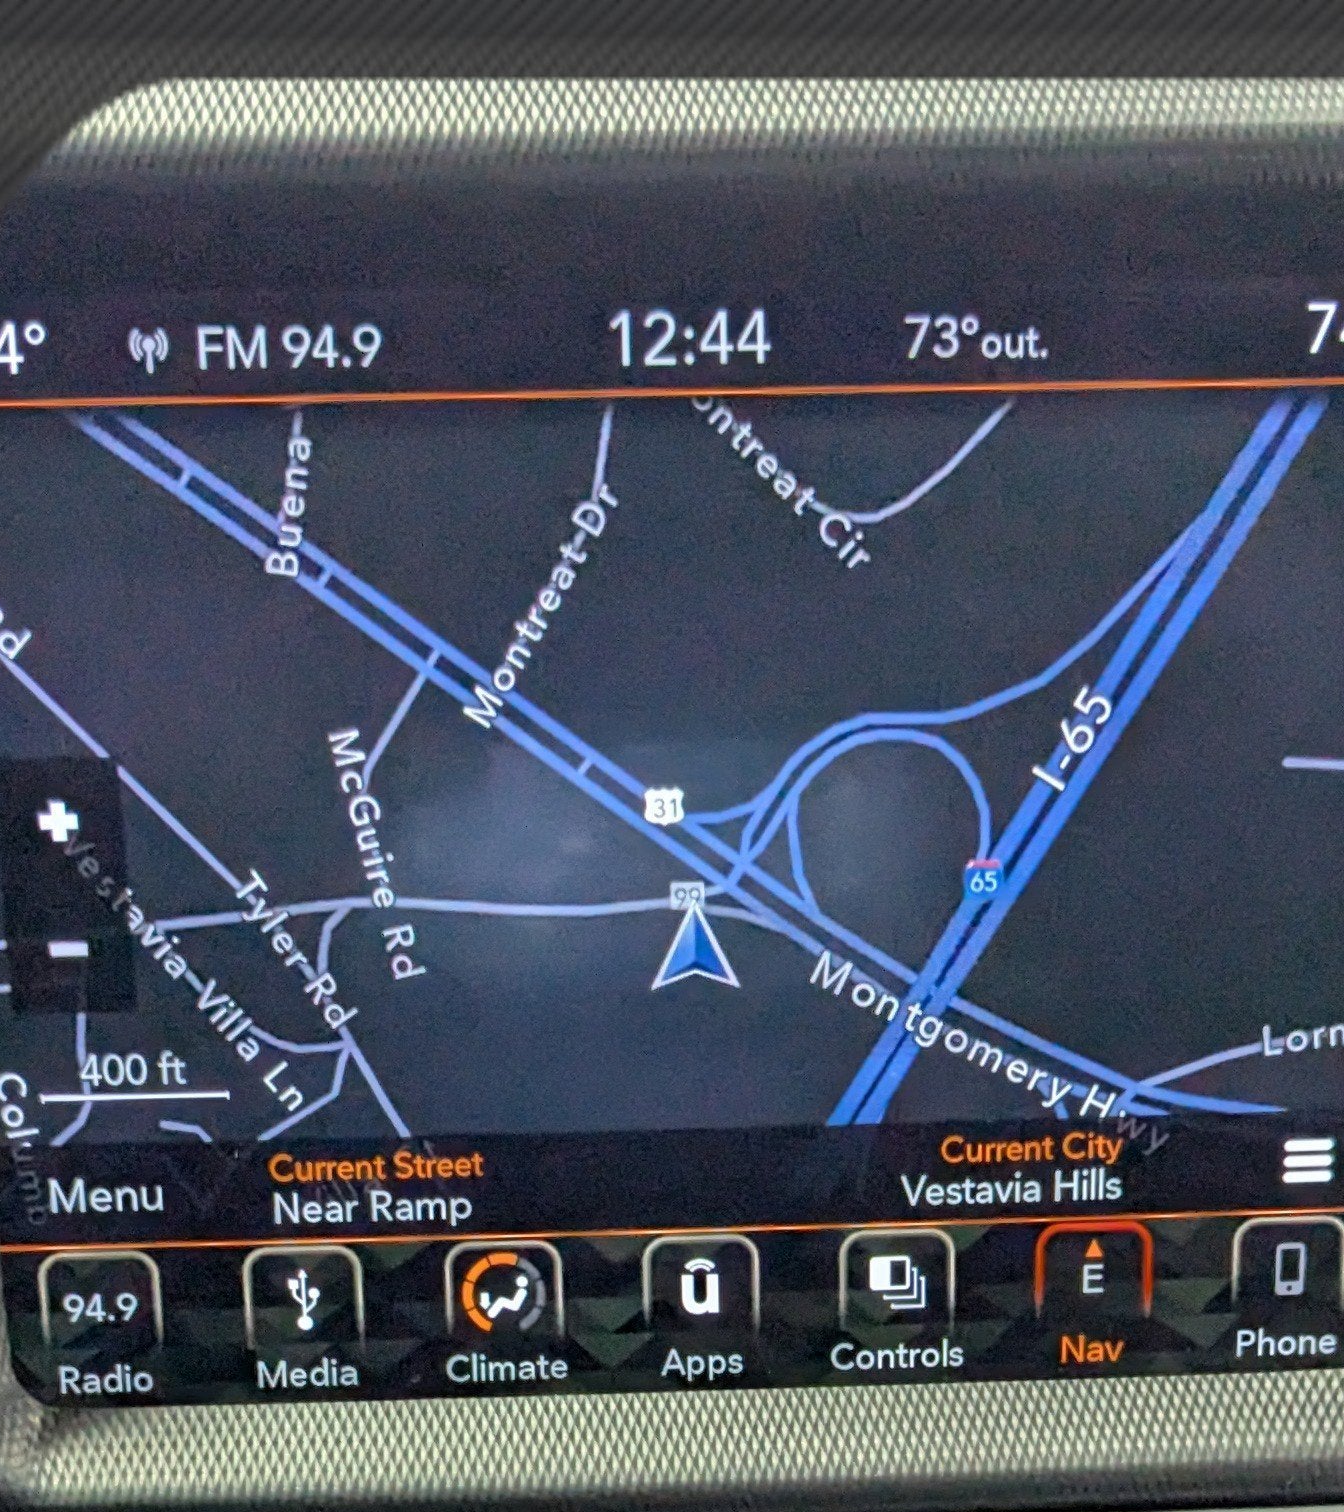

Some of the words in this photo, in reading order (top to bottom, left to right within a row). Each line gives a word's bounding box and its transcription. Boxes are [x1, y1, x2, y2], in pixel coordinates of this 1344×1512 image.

[198, 328, 268, 369] FM
[282, 325, 382, 369] 94.9
[609, 309, 771, 366] 12:44
[266, 436, 313, 577] Buena
[819, 512, 871, 568] Cir
[462, 538, 587, 728] Montreat
[573, 484, 619, 538] Dr
[1032, 686, 1113, 792] I-65
[653, 798, 680, 819] 31
[328, 729, 396, 910] McGuire
[381, 924, 426, 981] Rd
[970, 870, 998, 893] 65
[236, 868, 308, 968] Tyler
[303, 971, 358, 1029] Rd
[197, 979, 261, 1062] Villa
[262, 1060, 305, 1112] Ln
[810, 951, 1073, 1110] Montgomery
[79, 1054, 148, 1087] 400
[158, 1050, 187, 1085] ft
[267, 1151, 386, 1183] Current
[393, 1149, 484, 1180] Street
[939, 1134, 1054, 1164] Current
[1061, 1130, 1125, 1166] City
[47, 1177, 164, 1214] Menu
[900, 1170, 1042, 1207] Vestavia
[1054, 1166, 1124, 1203] Hills
[272, 1190, 359, 1225] Near
[369, 1188, 473, 1228] Ramp
[1082, 1263, 1106, 1294] E
[62, 1293, 139, 1324] 94.9
[830, 1340, 964, 1371] Controls
[1059, 1333, 1125, 1364] Nav
[1235, 1329, 1338, 1358] Phone
[58, 1362, 155, 1395] Radio
[256, 1359, 358, 1389] Media
[445, 1352, 569, 1383] Climate
[661, 1348, 744, 1382] Apps
